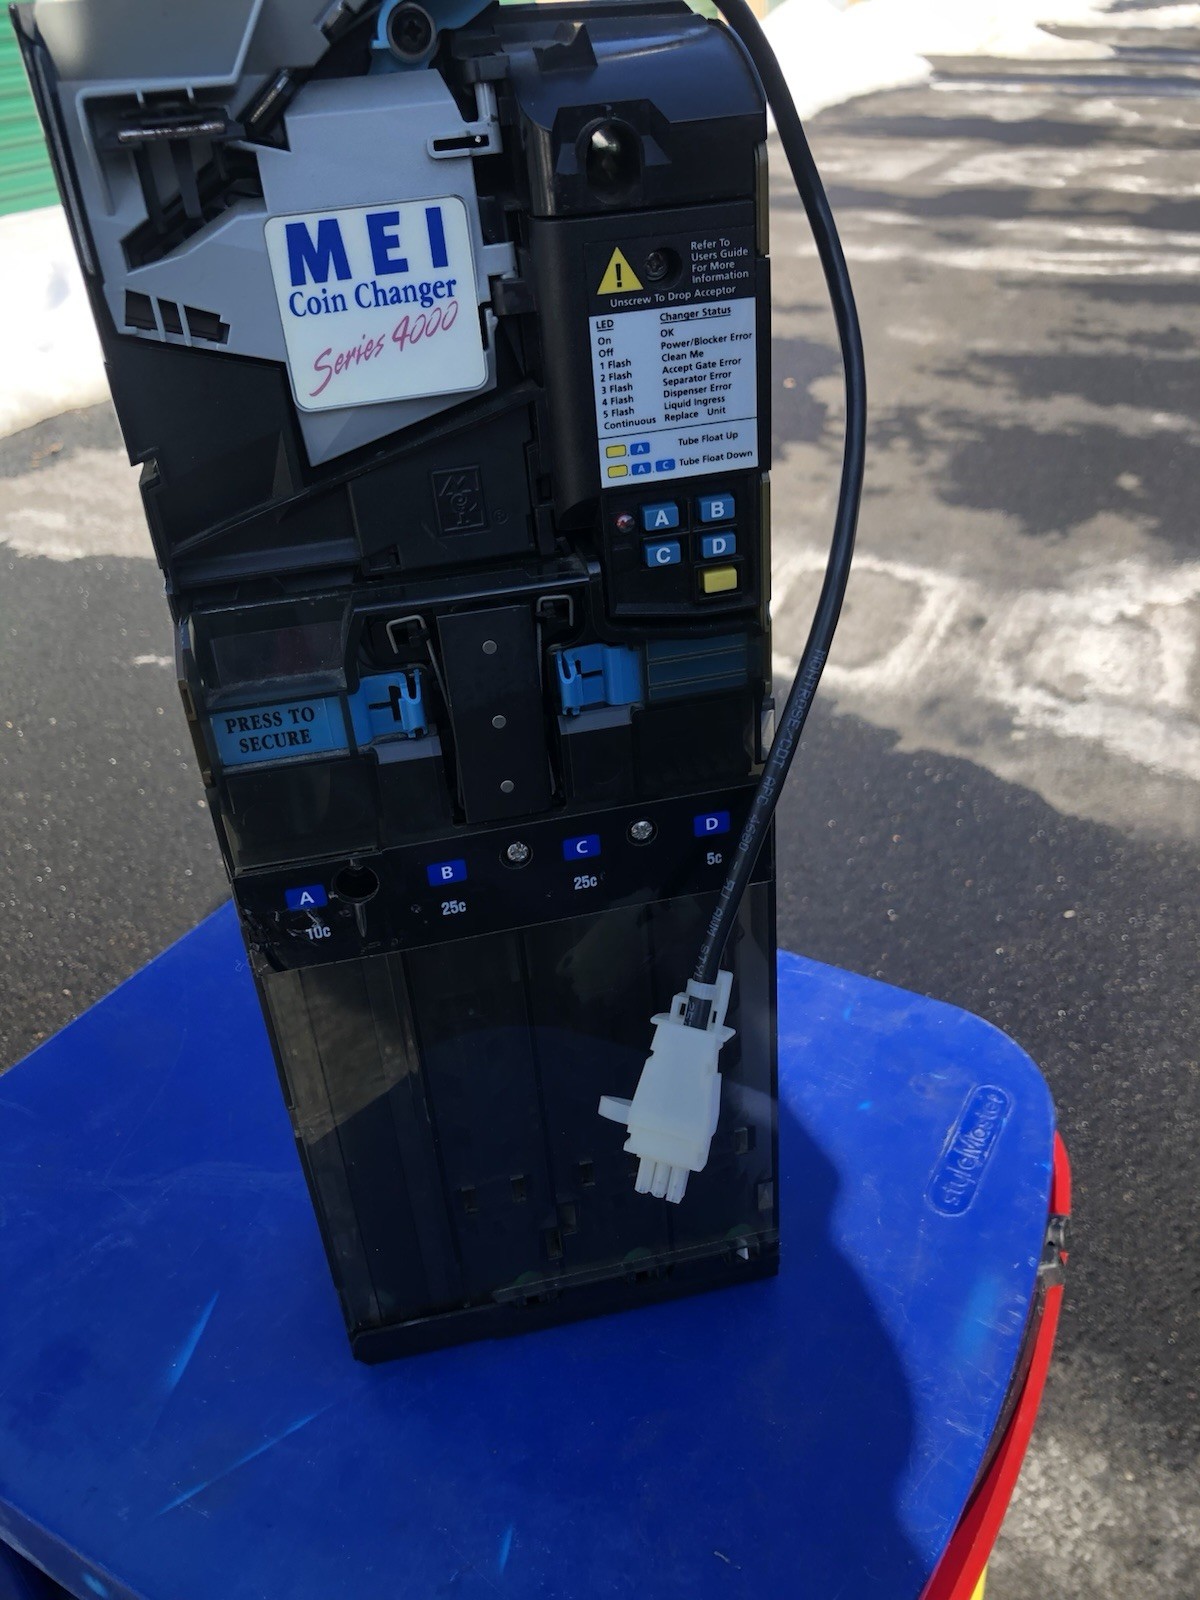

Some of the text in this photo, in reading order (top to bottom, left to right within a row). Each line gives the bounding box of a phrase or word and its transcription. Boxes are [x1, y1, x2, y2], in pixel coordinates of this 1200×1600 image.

[285, 206, 449, 287] MEI
[690, 238, 731, 251] Refer To
[691, 247, 749, 262] Users Guide
[691, 260, 735, 273] For More
[692, 270, 750, 284] Information
[289, 278, 457, 317] Coin Changer
[610, 285, 737, 308] Unscrew To Drop Acceptor
[659, 306, 731, 323] Changer Status
[596, 319, 614, 331] LED
[660, 328, 675, 338] OK
[661, 331, 753, 349] Power/Blocker Error
[309, 300, 459, 397] Series 4000
[597, 337, 612, 346] On
[598, 348, 614, 358] Off
[661, 349, 704, 363] Clean Me
[608, 358, 632, 370] Flash
[662, 357, 742, 375] Accept Gate Error
[600, 371, 633, 383] 2 Flash
[662, 370, 732, 388] Separator Error
[601, 383, 634, 395] 3 Flash
[663, 382, 732, 400] Dispenser Error
[602, 395, 634, 406] 4 Flash
[664, 395, 726, 410] Liquid Ingress
[603, 407, 635, 419] 5 Flash
[664, 406, 726, 423] Replace Unit
[604, 416, 657, 430] Continuous
[678, 431, 739, 447] Tube Float Up
[679, 450, 753, 467] Tube Float Down
[710, 501, 725, 519] B
[654, 509, 670, 527] A
[712, 538, 727, 555] D
[655, 547, 671, 564] C
[225, 706, 316, 734] PRESS TO
[239, 728, 312, 754] SECURE
[705, 817, 719, 831] D
[576, 840, 589, 855] C
[706, 851, 723, 866] 5c
[441, 866, 454, 880] B
[573, 874, 598, 891] 25c
[299, 891, 315, 906] A
[440, 900, 467, 917] 25c
